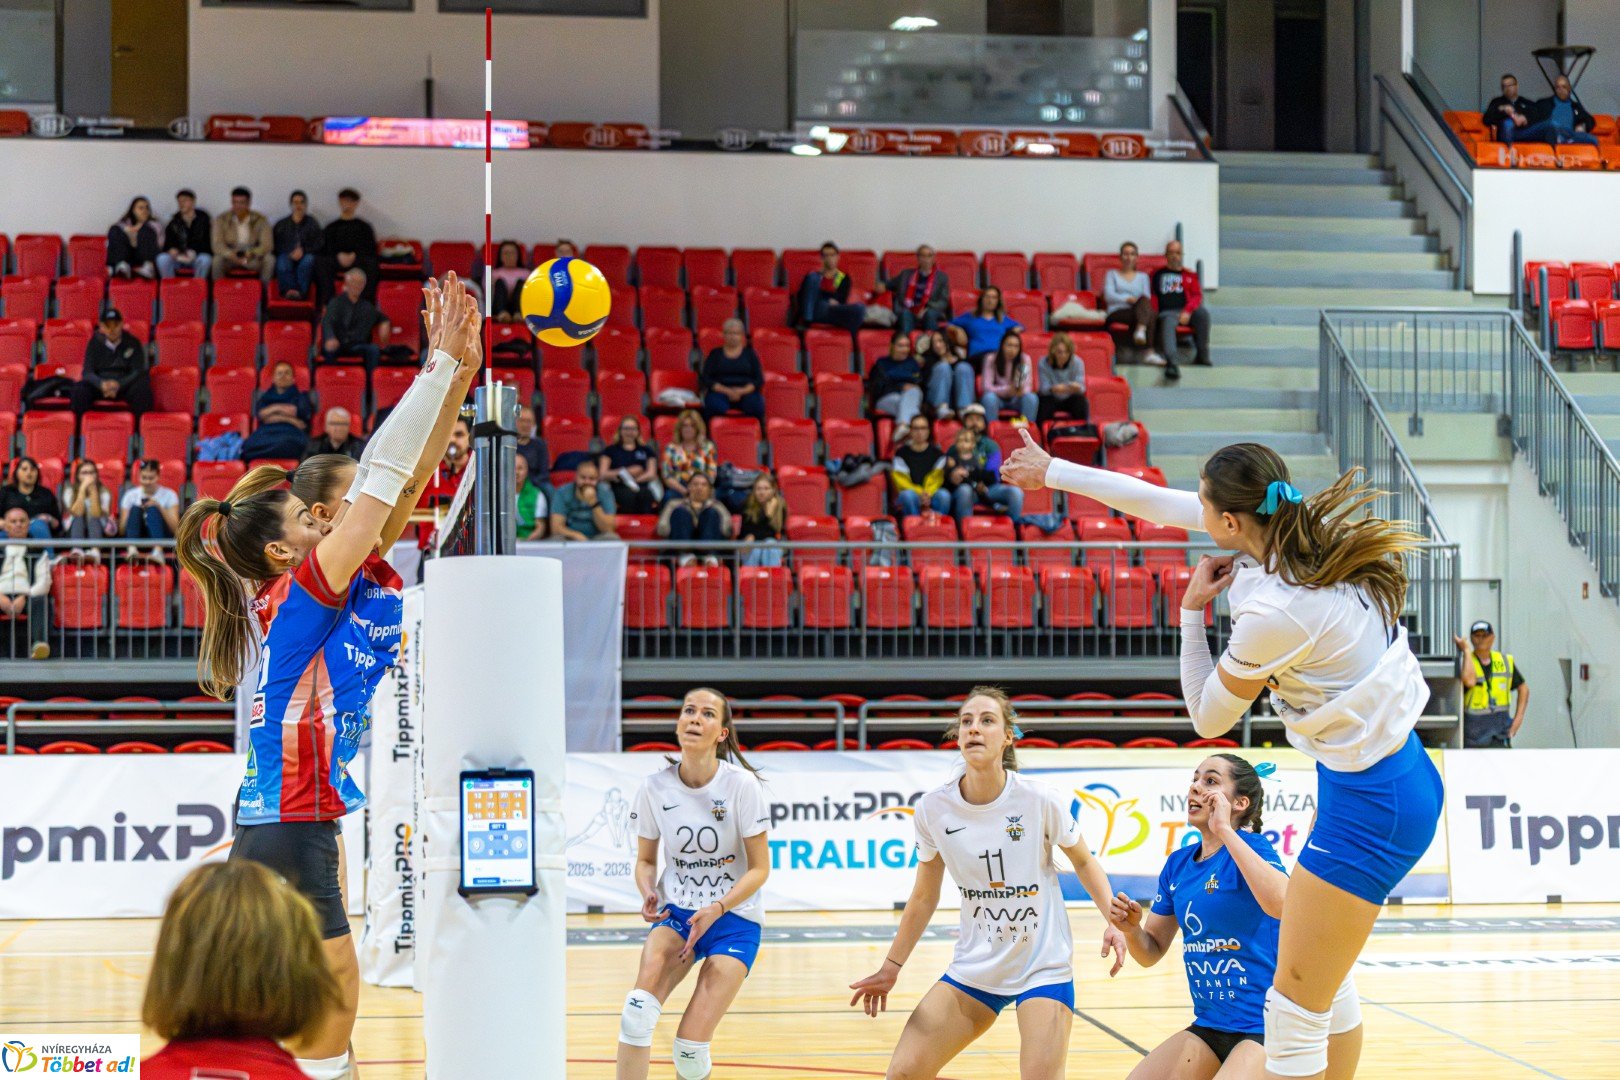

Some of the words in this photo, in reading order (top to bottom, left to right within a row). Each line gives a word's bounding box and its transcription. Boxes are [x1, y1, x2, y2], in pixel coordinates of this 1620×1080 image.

[392, 630, 415, 763] TippmixP
[1160, 791, 1316, 812] NYHÁZA
[2, 803, 236, 880] pmixP
[676, 826, 719, 854] 20
[567, 862, 595, 877] 2025
[604, 862, 632, 876] 2026
[978, 848, 1005, 882] 11
[395, 822, 414, 954] TippmixPRO
[673, 886, 734, 898] VITAMI
[1184, 900, 1203, 936] 6
